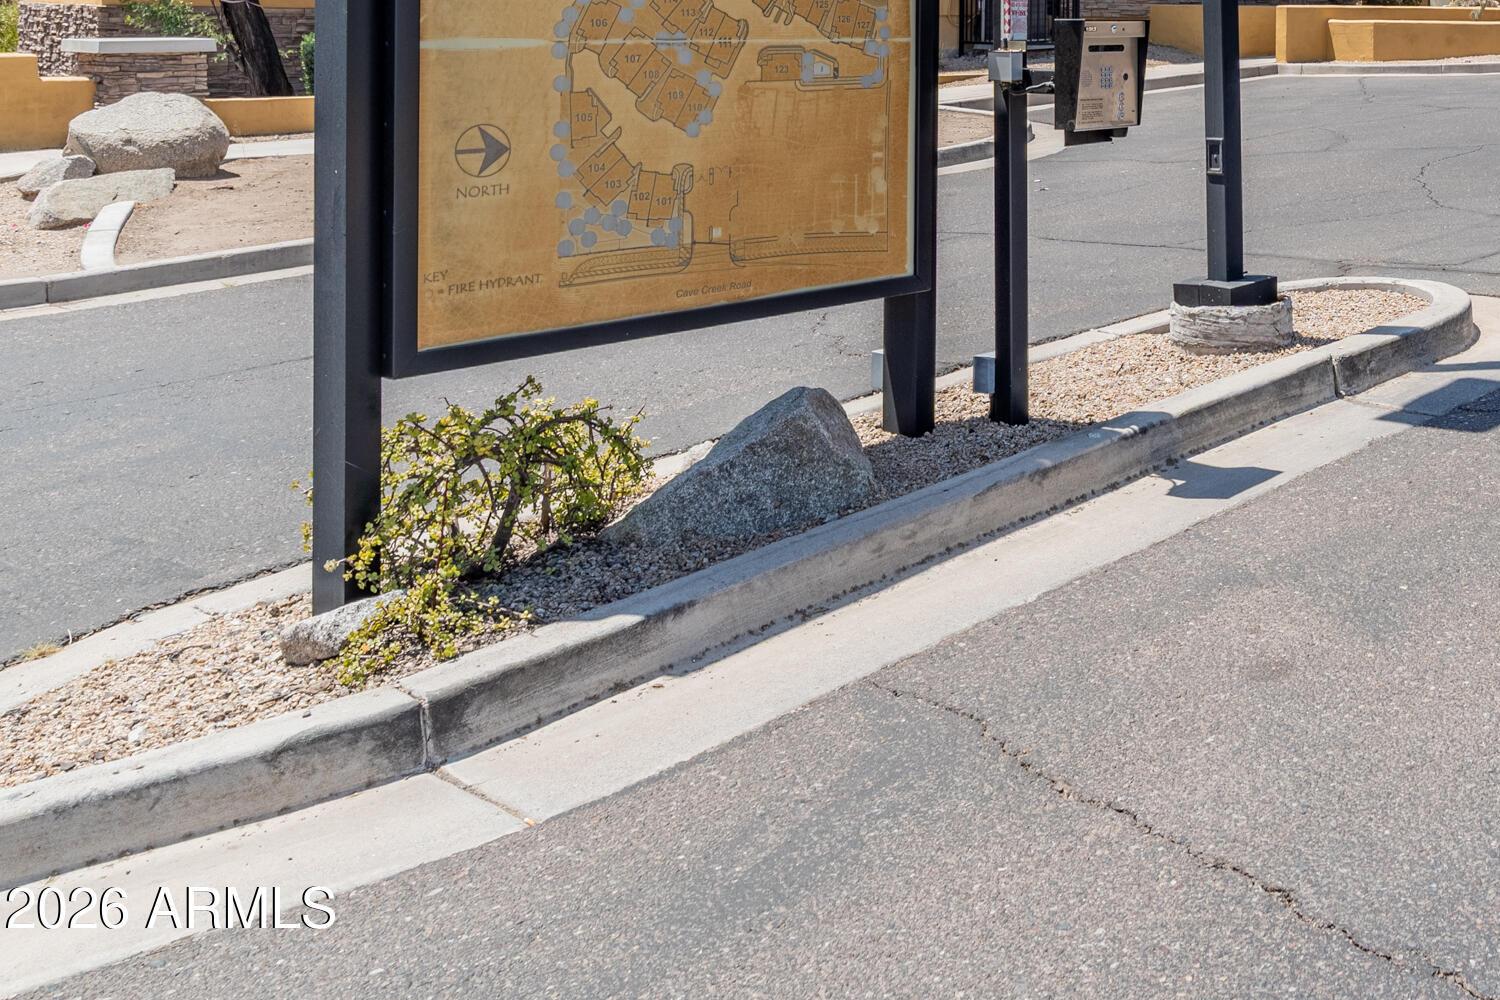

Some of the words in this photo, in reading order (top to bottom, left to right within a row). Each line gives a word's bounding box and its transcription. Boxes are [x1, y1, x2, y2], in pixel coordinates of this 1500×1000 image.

[815, 1, 829, 9] 125
[681, 8, 696, 17] 113
[590, 19, 608, 28] 106
[857, 22, 870, 30] 127
[699, 28, 713, 37] 112
[625, 55, 640, 63] 107
[576, 113, 592, 122] 105
[588, 163, 605, 172] 104
[604, 180, 622, 188] 103
[456, 184, 510, 199] NORTH
[634, 192, 650, 201] 102
[656, 197, 672, 206] 101
[424, 270, 448, 283] KEY
[448, 281, 476, 295] FIRE
[480, 273, 543, 290] HYDRANT
[676, 288, 698, 298] Cave
[702, 284, 726, 294] Creek
[729, 280, 752, 290] Road
